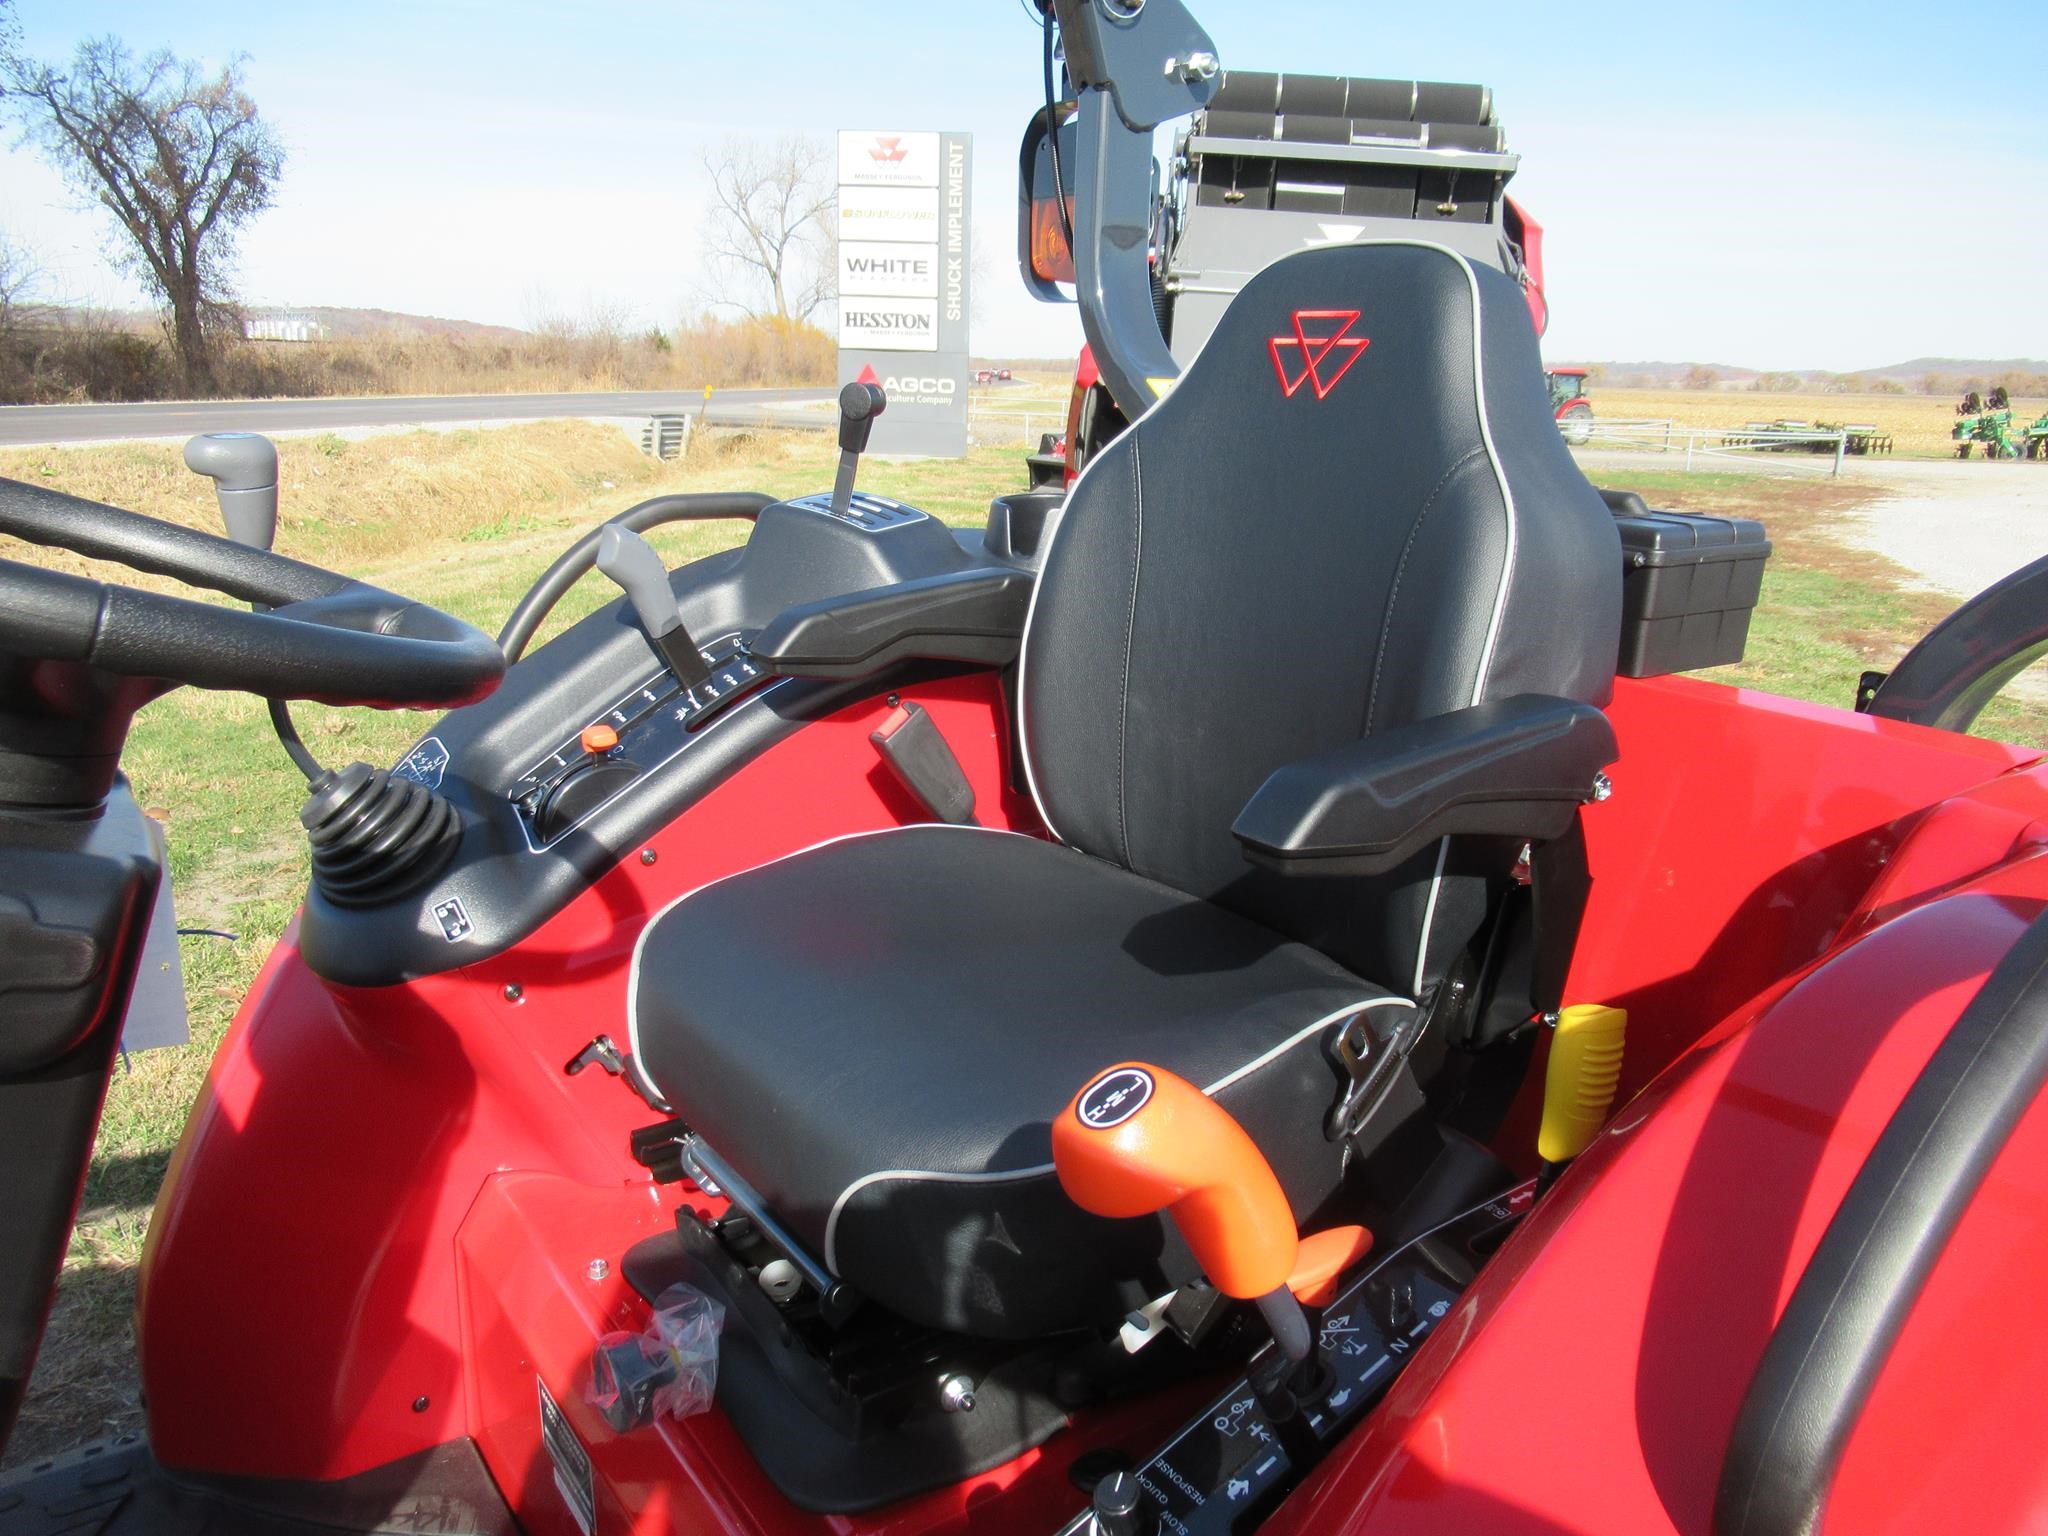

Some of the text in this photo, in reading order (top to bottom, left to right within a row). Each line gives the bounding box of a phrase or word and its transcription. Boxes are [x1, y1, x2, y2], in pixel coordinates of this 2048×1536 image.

[947, 141, 964, 321] SHUCK IMPLEMENT
[847, 258, 929, 274] WHITE
[845, 311, 931, 329] HESSTON
[883, 376, 956, 394] AGCO
[917, 394, 953, 406] Company
[1389, 1337, 1410, 1354] N
[1137, 1474, 1169, 1504] QUICK
[1154, 1458, 1207, 1506] RESPONSE
[1160, 1510, 1189, 1536] SLOW
